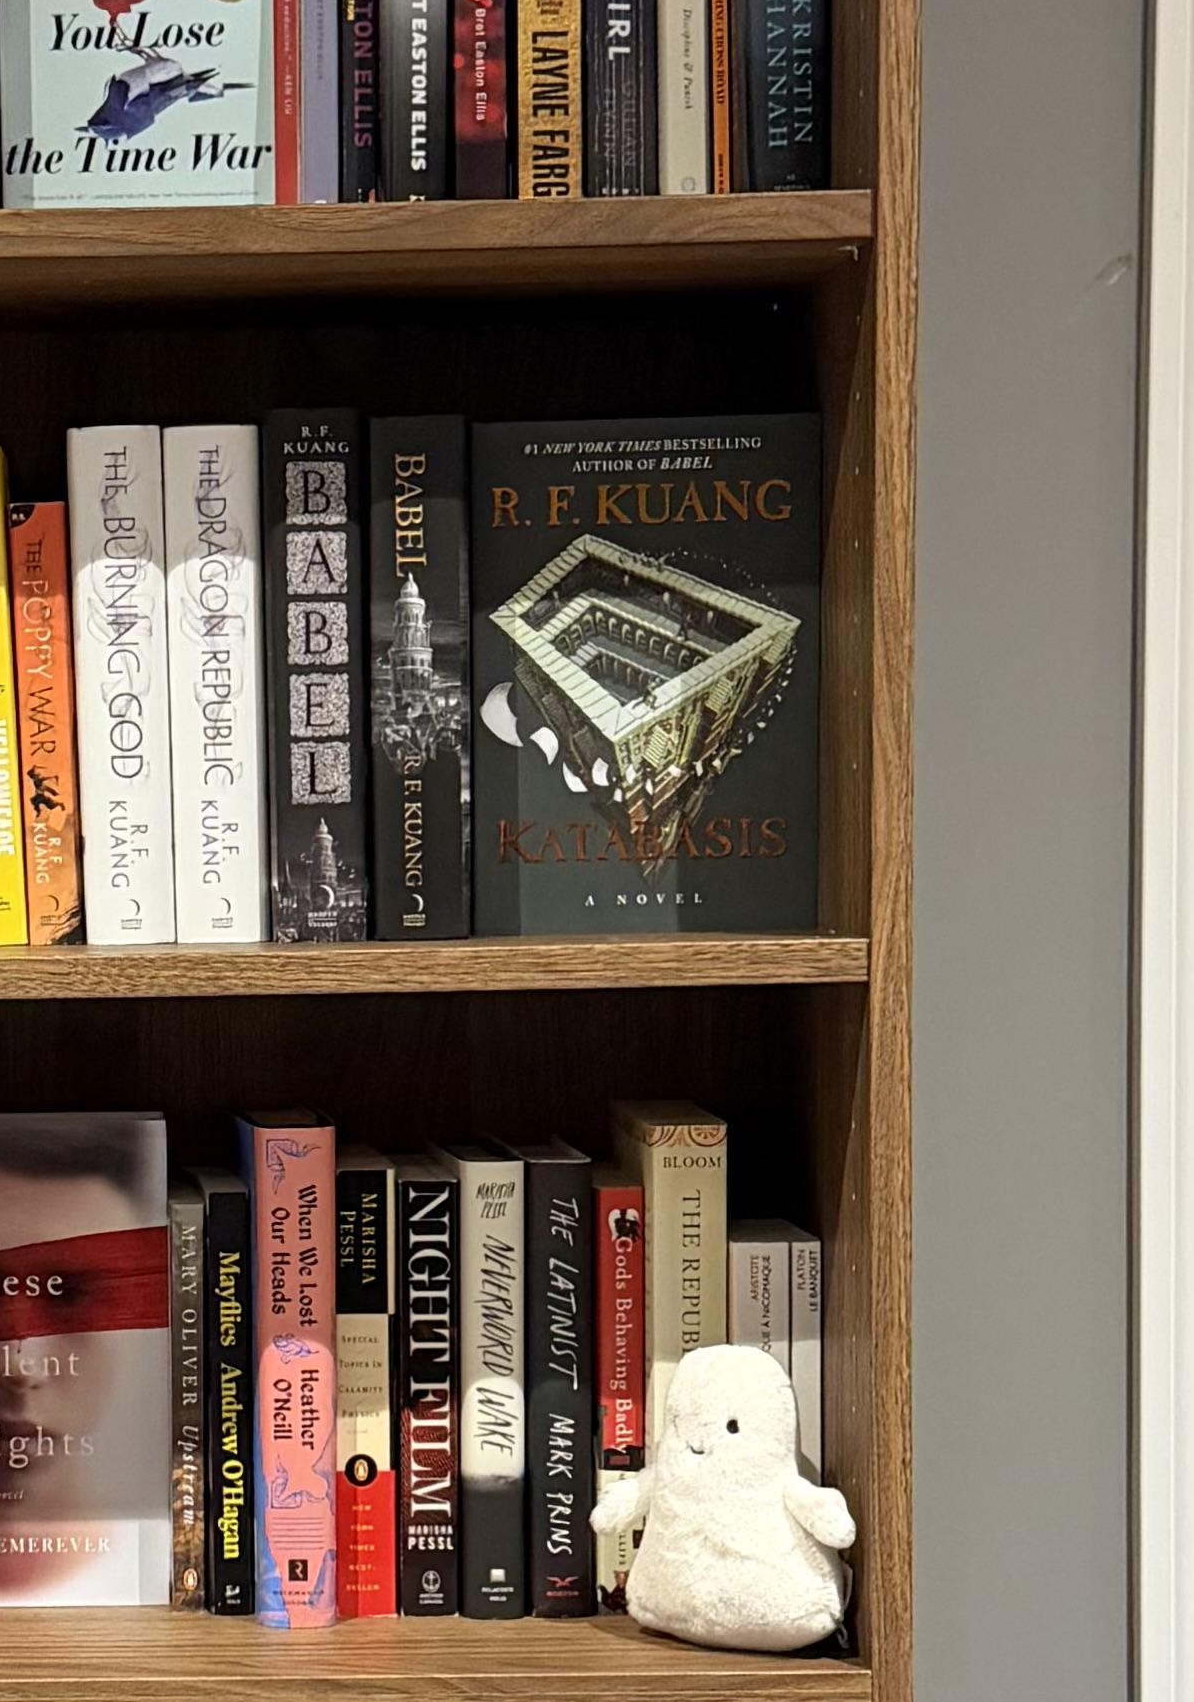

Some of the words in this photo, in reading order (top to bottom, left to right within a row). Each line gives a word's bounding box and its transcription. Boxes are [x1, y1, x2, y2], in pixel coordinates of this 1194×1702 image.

[50, 13, 116, 51] You
[126, 11, 224, 50] Lose
[6, 138, 63, 175] the
[74, 135, 176, 174] Time
[191, 132, 271, 171] War
[543, 442, 576, 454] NEW
[578, 441, 614, 453] YORK
[618, 439, 661, 452] TIMES
[663, 436, 762, 451] BESTSELLING
[572, 459, 633, 473] AUTHOR
[637, 458, 656, 470] OF
[660, 455, 713, 470] BABEL
[104, 447, 128, 500] THE
[394, 454, 427, 578] BABEL
[491, 487, 531, 528] R.
[547, 486, 580, 526] F.
[596, 479, 792, 524] KUANG
[104, 517, 142, 686] BURNING
[107, 693, 143, 780] GOD
[497, 817, 788, 864] KATABASIS
[585, 895, 594, 906] A
[617, 893, 703, 905] NOVEL
[662, 1156, 721, 1170] BLOOM
[408, 1187, 451, 1362] NIGHT
[614, 1237, 632, 1293] Gods
[215, 1251, 240, 1346] Mayflies
[610, 1299, 632, 1391] Behaving
[220, 1363, 243, 1451] Andrew
[614, 1398, 634, 1453] Badly
[410, 1376, 452, 1519] FILM
[217, 1458, 244, 1560] O'Hagan
[408, 1536, 454, 1551] PESSL
